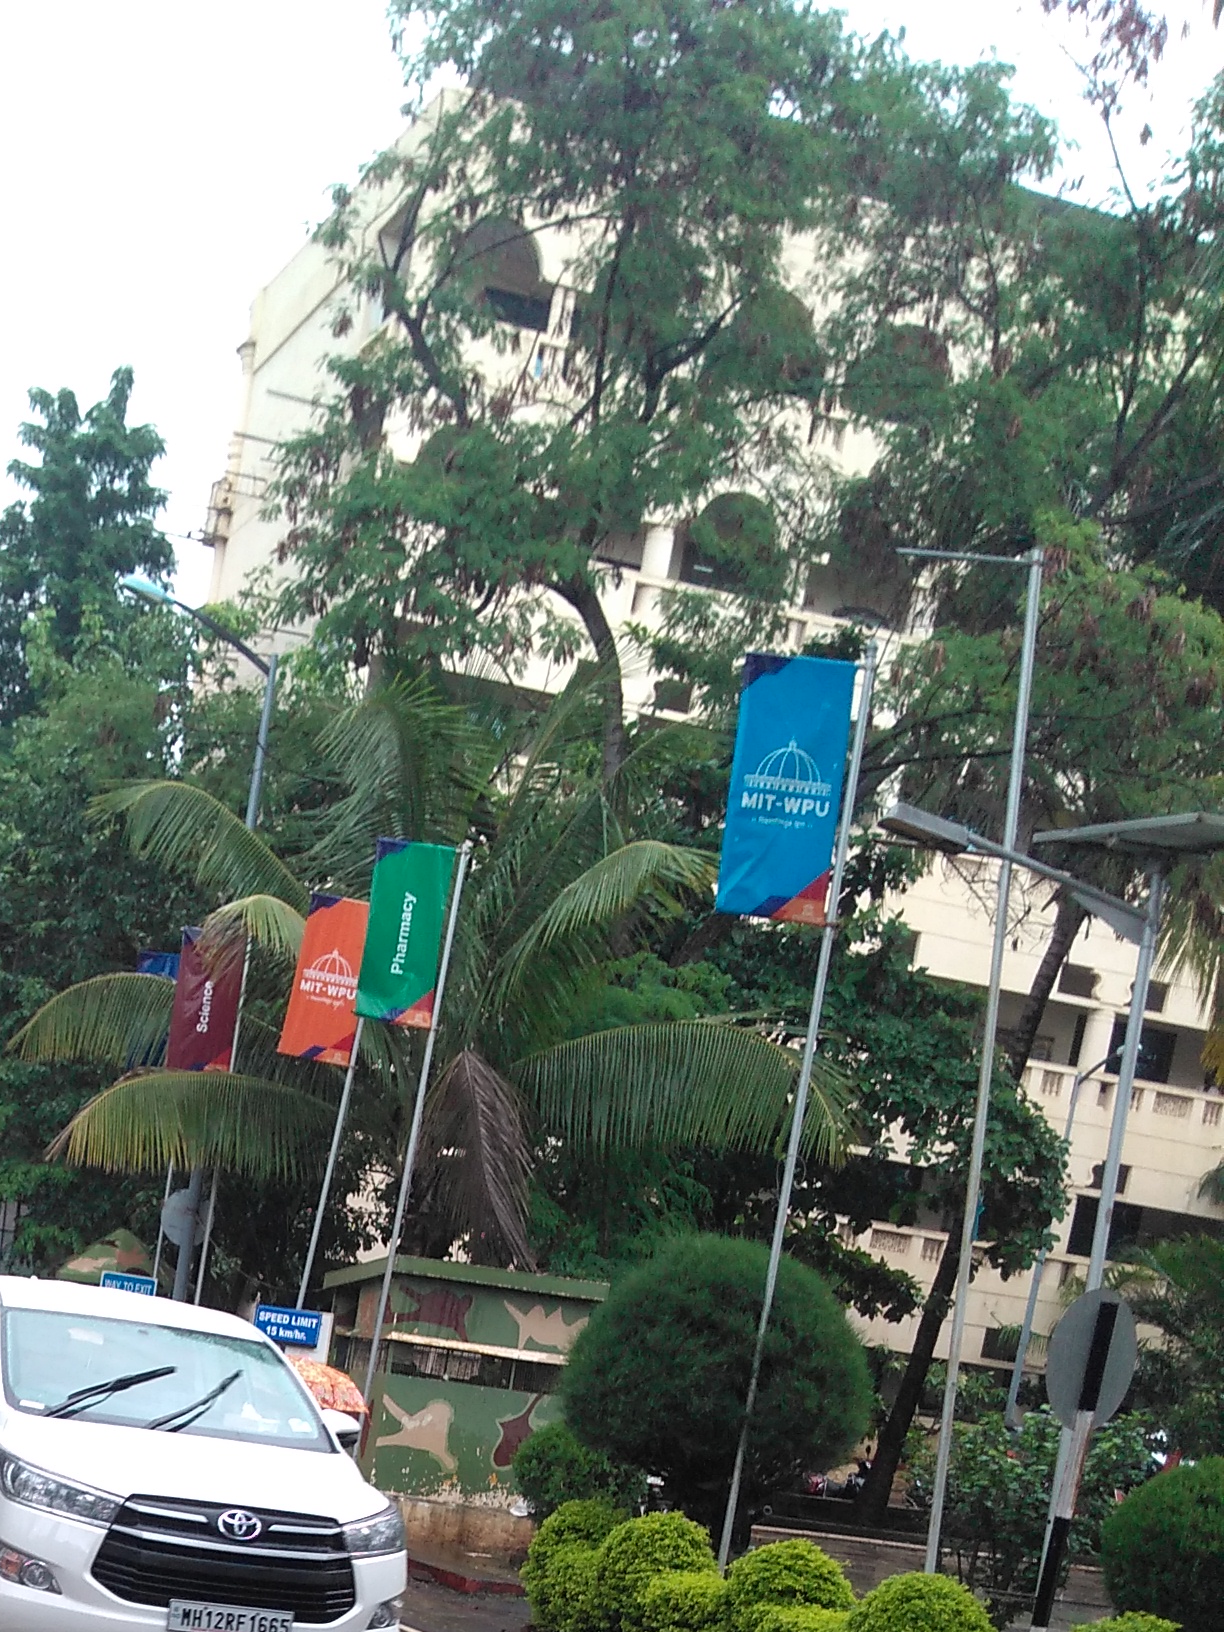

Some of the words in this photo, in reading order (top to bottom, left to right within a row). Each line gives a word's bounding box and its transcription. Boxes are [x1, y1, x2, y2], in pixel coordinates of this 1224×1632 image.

[741, 790, 830, 818] MIT-WPU
[390, 891, 417, 975] Pharmacy
[299, 978, 356, 1000] MIT-WPU
[196, 980, 214, 1033] Science
[104, 1278, 122, 1290] WAY
[123, 1281, 134, 1293] TO
[134, 1282, 152, 1296] EXIT
[259, 1311, 290, 1325] SPEED
[291, 1315, 318, 1330] LIMIT
[265, 1324, 278, 1337] 15
